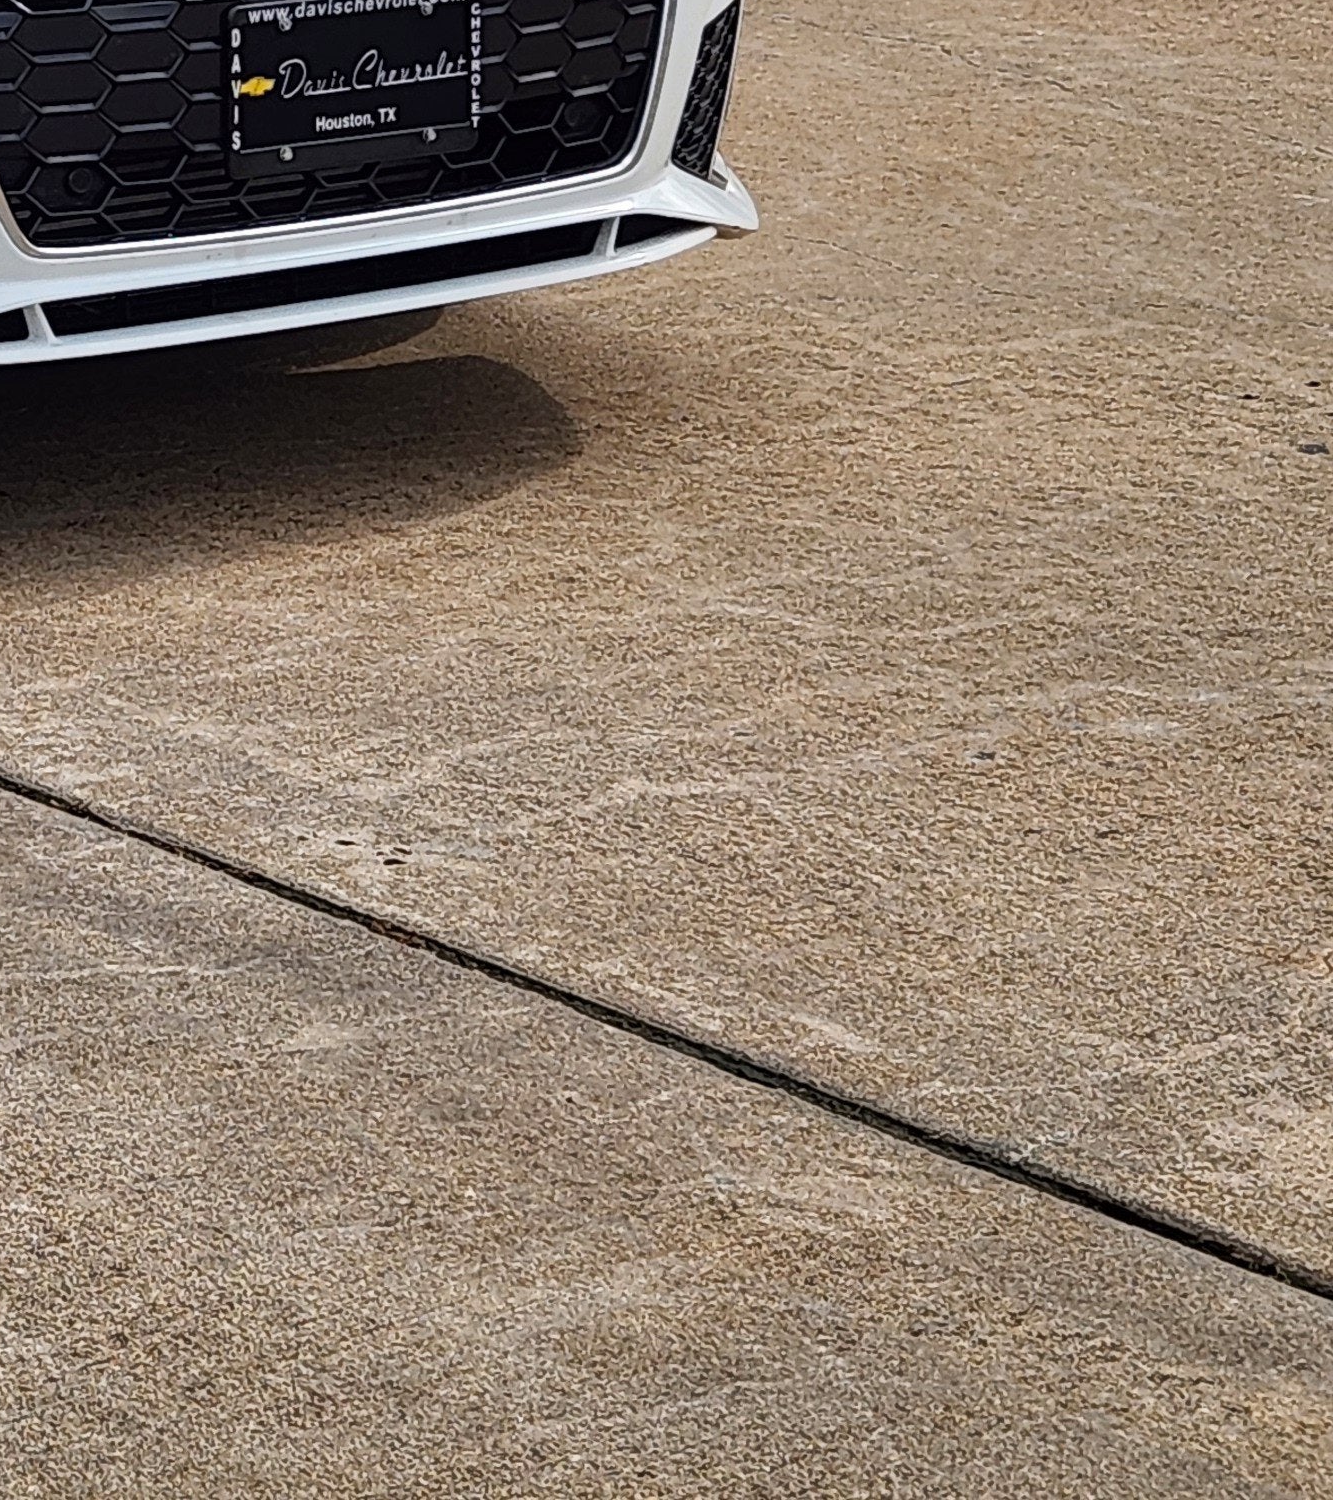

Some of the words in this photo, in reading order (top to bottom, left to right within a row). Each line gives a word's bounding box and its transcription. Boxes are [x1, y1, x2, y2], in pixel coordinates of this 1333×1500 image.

[230, 27, 242, 151] DAVIS
[278, 58, 352, 99] Davis
[352, 49, 469, 90] Chevrolet
[470, 2, 482, 128] CHEVROLET
[315, 114, 376, 133] Houston,
[378, 106, 397, 124] TX
